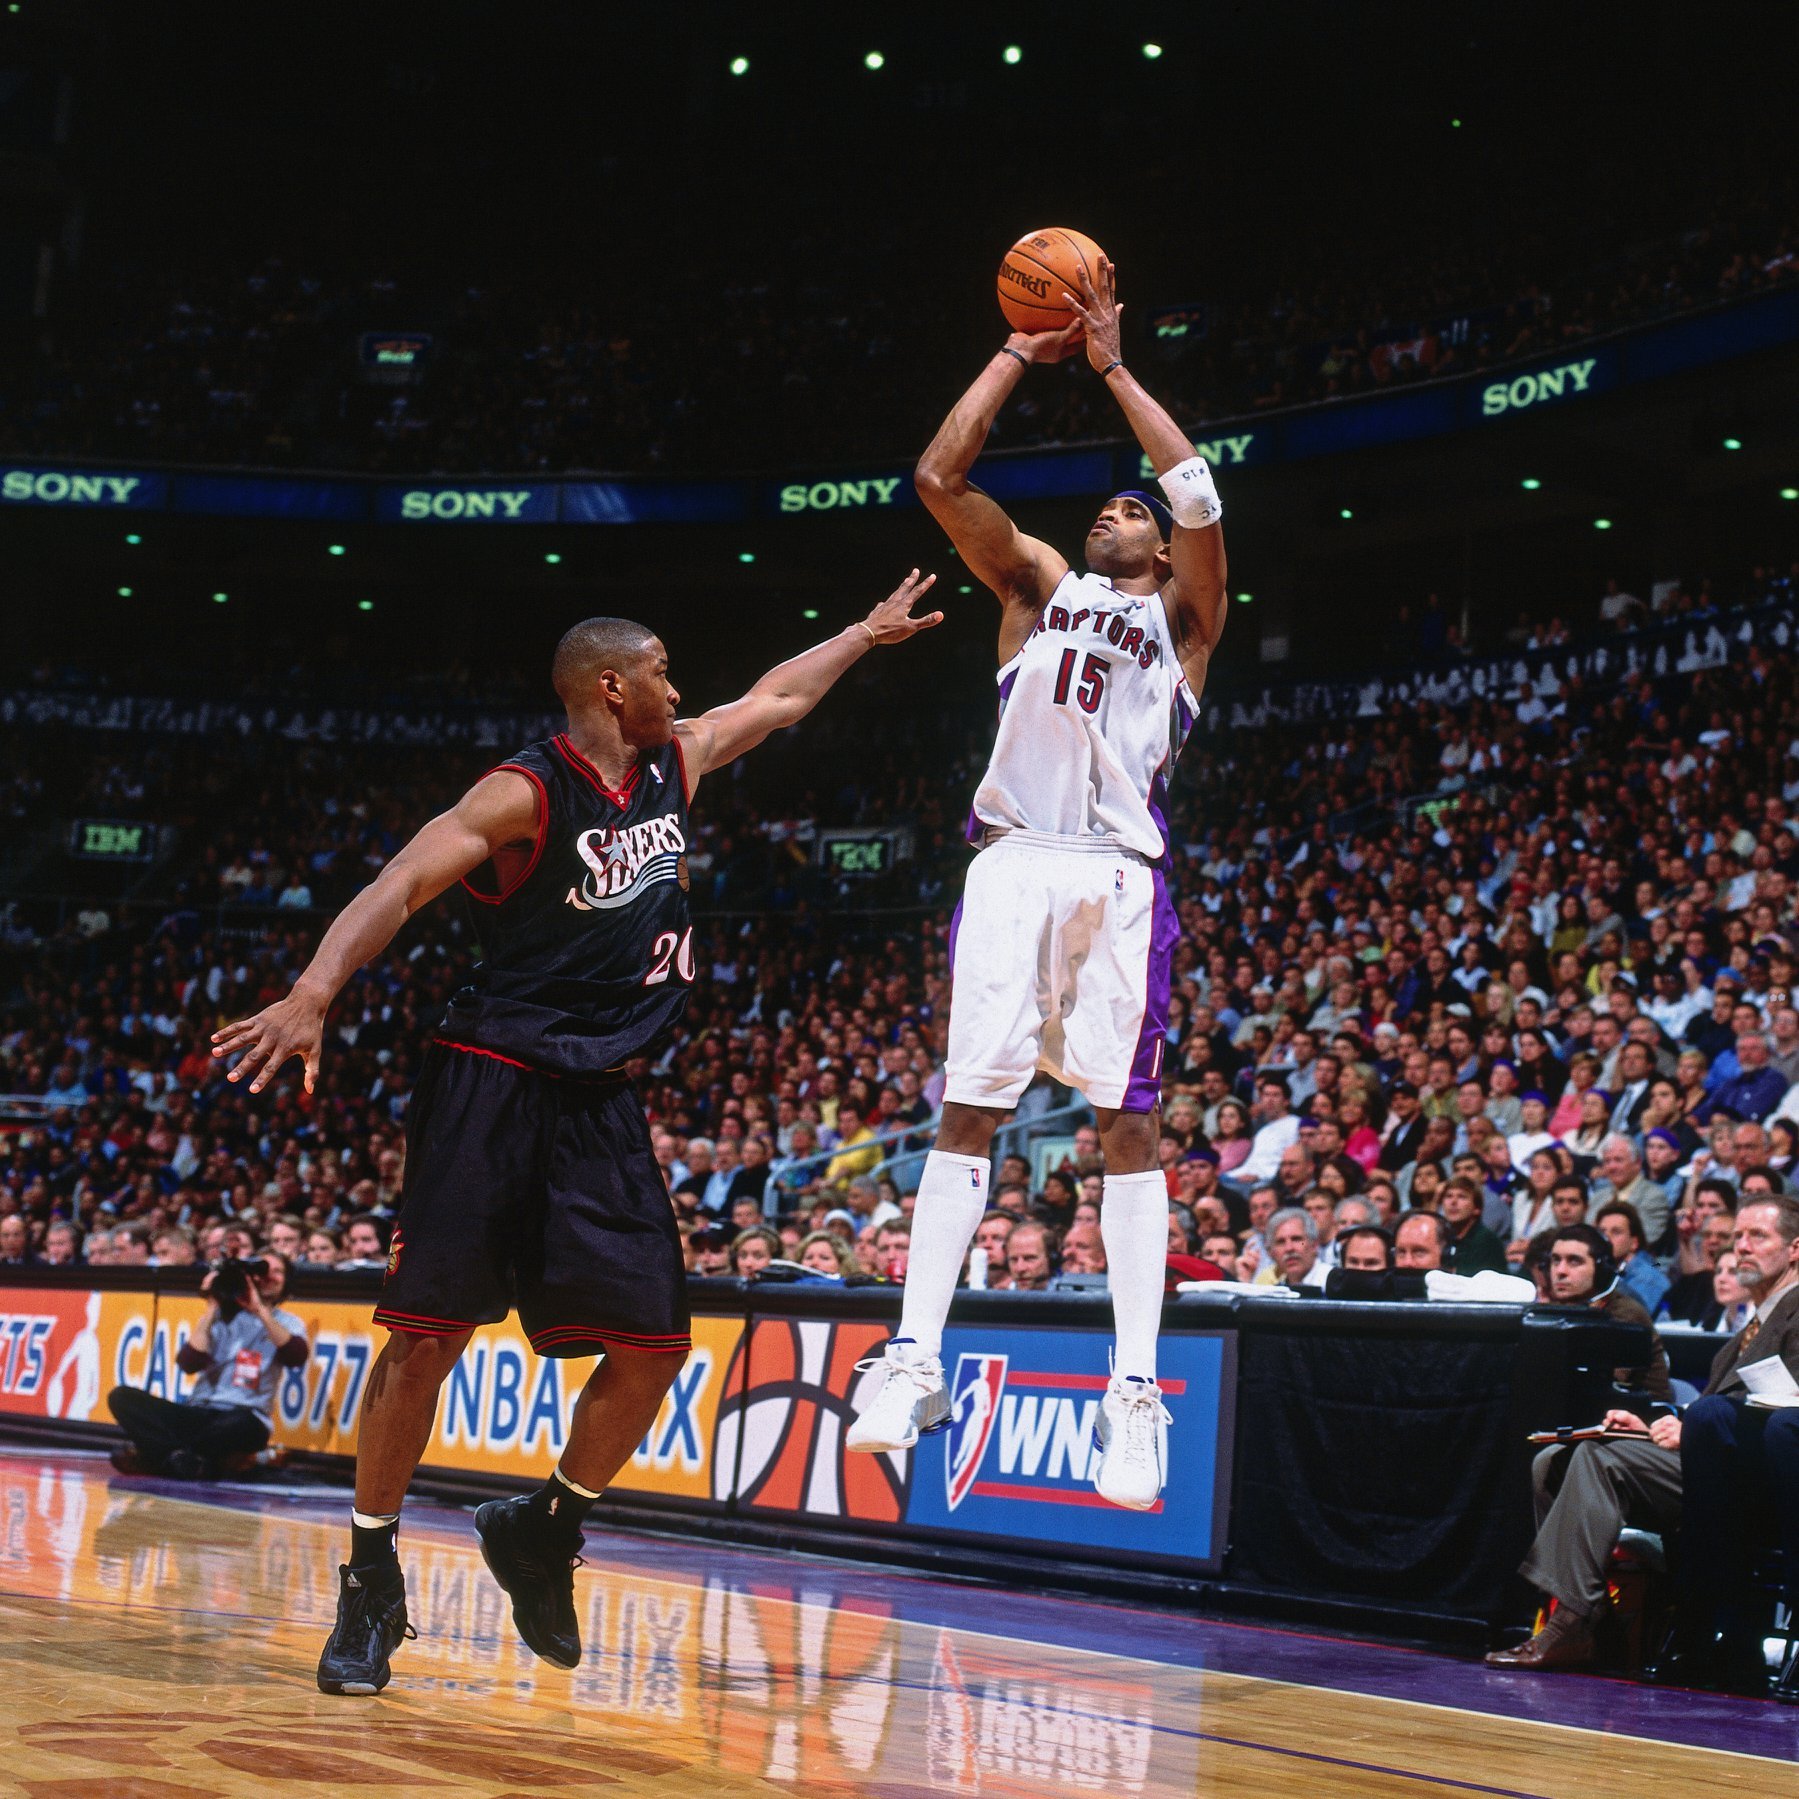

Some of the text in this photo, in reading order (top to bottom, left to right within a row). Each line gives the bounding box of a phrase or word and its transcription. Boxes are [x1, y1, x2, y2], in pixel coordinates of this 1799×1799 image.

[1482, 358, 1597, 416] SONY
[1, 470, 140, 503] SONY
[401, 490, 531, 519] SONY
[779, 477, 901, 512] SONY
[1053, 647, 1112, 714] 15
[643, 926, 696, 987] 20
[279, 1332, 374, 1436] 877
[441, 1336, 568, 1456] NBA
